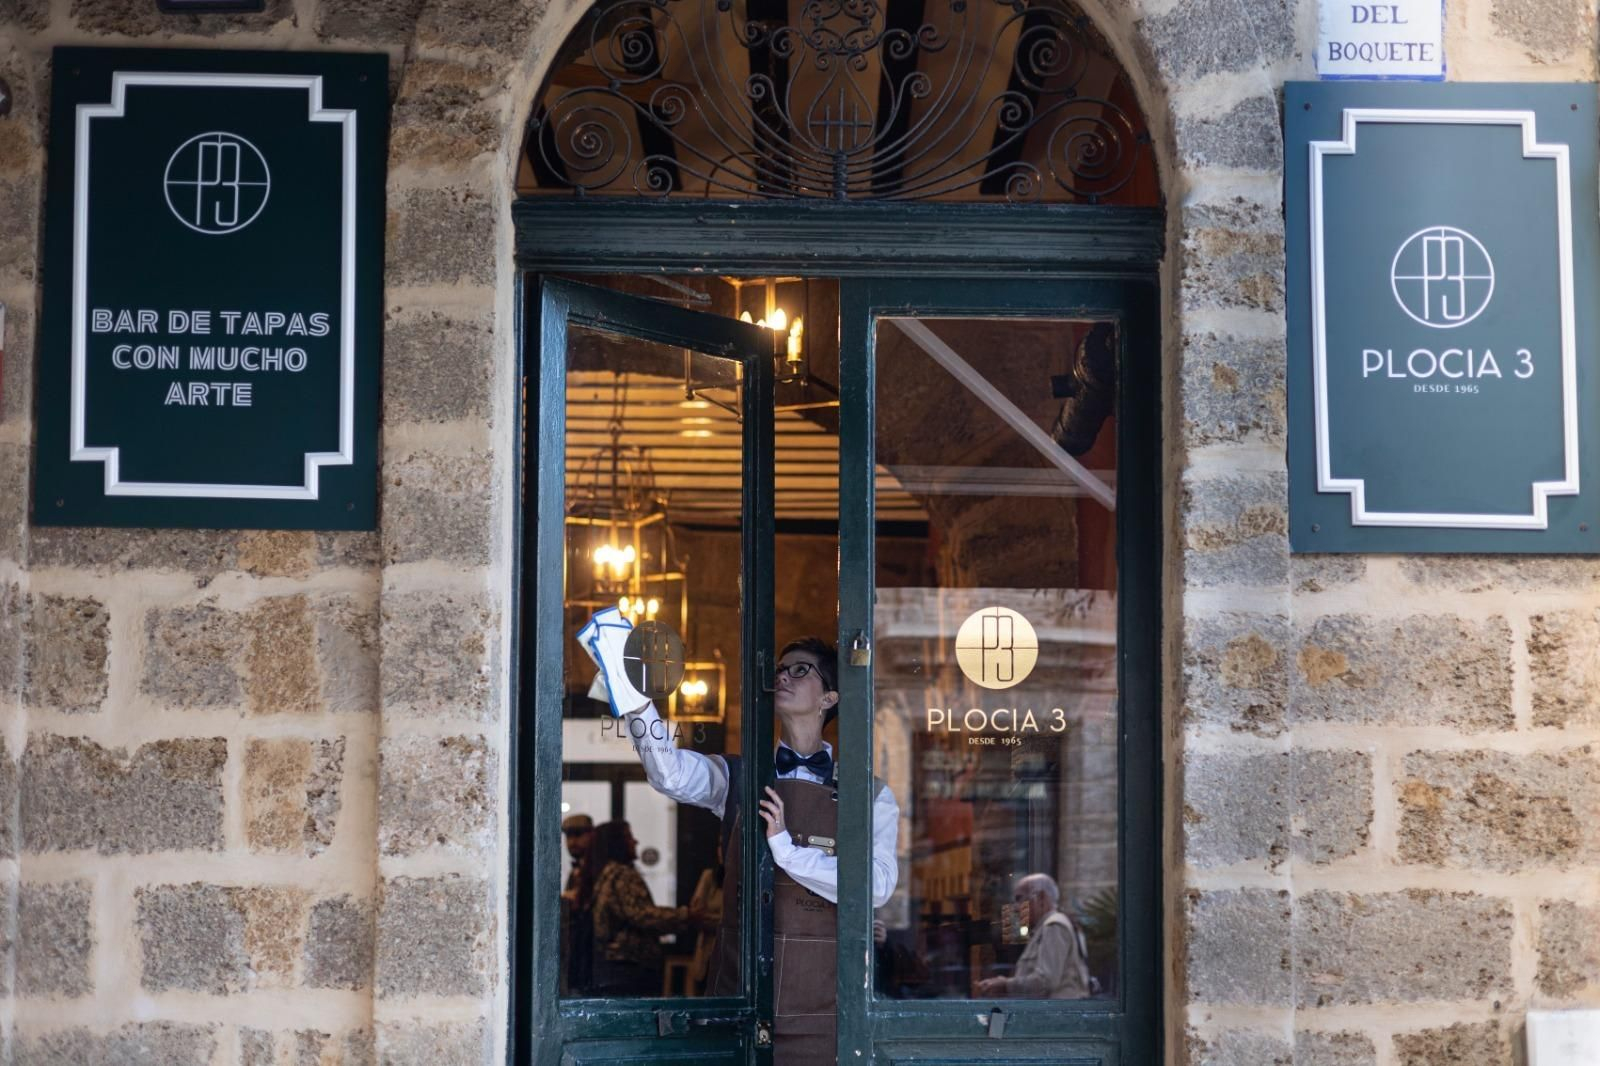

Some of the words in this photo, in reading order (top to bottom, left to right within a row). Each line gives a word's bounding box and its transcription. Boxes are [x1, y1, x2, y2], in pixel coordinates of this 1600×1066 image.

[1351, 5, 1409, 24] DEL
[1328, 41, 1434, 62] BOQUETE
[91, 309, 159, 333] BAR
[168, 310, 211, 334] DE
[220, 311, 331, 336] TAPAS
[112, 345, 179, 370] CON
[189, 346, 308, 372] MUCHO
[1362, 349, 1502, 378] PLOCIA
[1514, 348, 1534, 378] 3
[164, 382, 252, 406] ARTE
[1413, 384, 1450, 393] DESDE
[1455, 384, 1480, 394] 1965
[601, 715, 684, 742] PLOCIA
[694, 722, 706, 744] 3
[927, 708, 1039, 732] PLOCIA
[1050, 708, 1067, 732] 3
[1001, 736, 1022, 746] 1965
